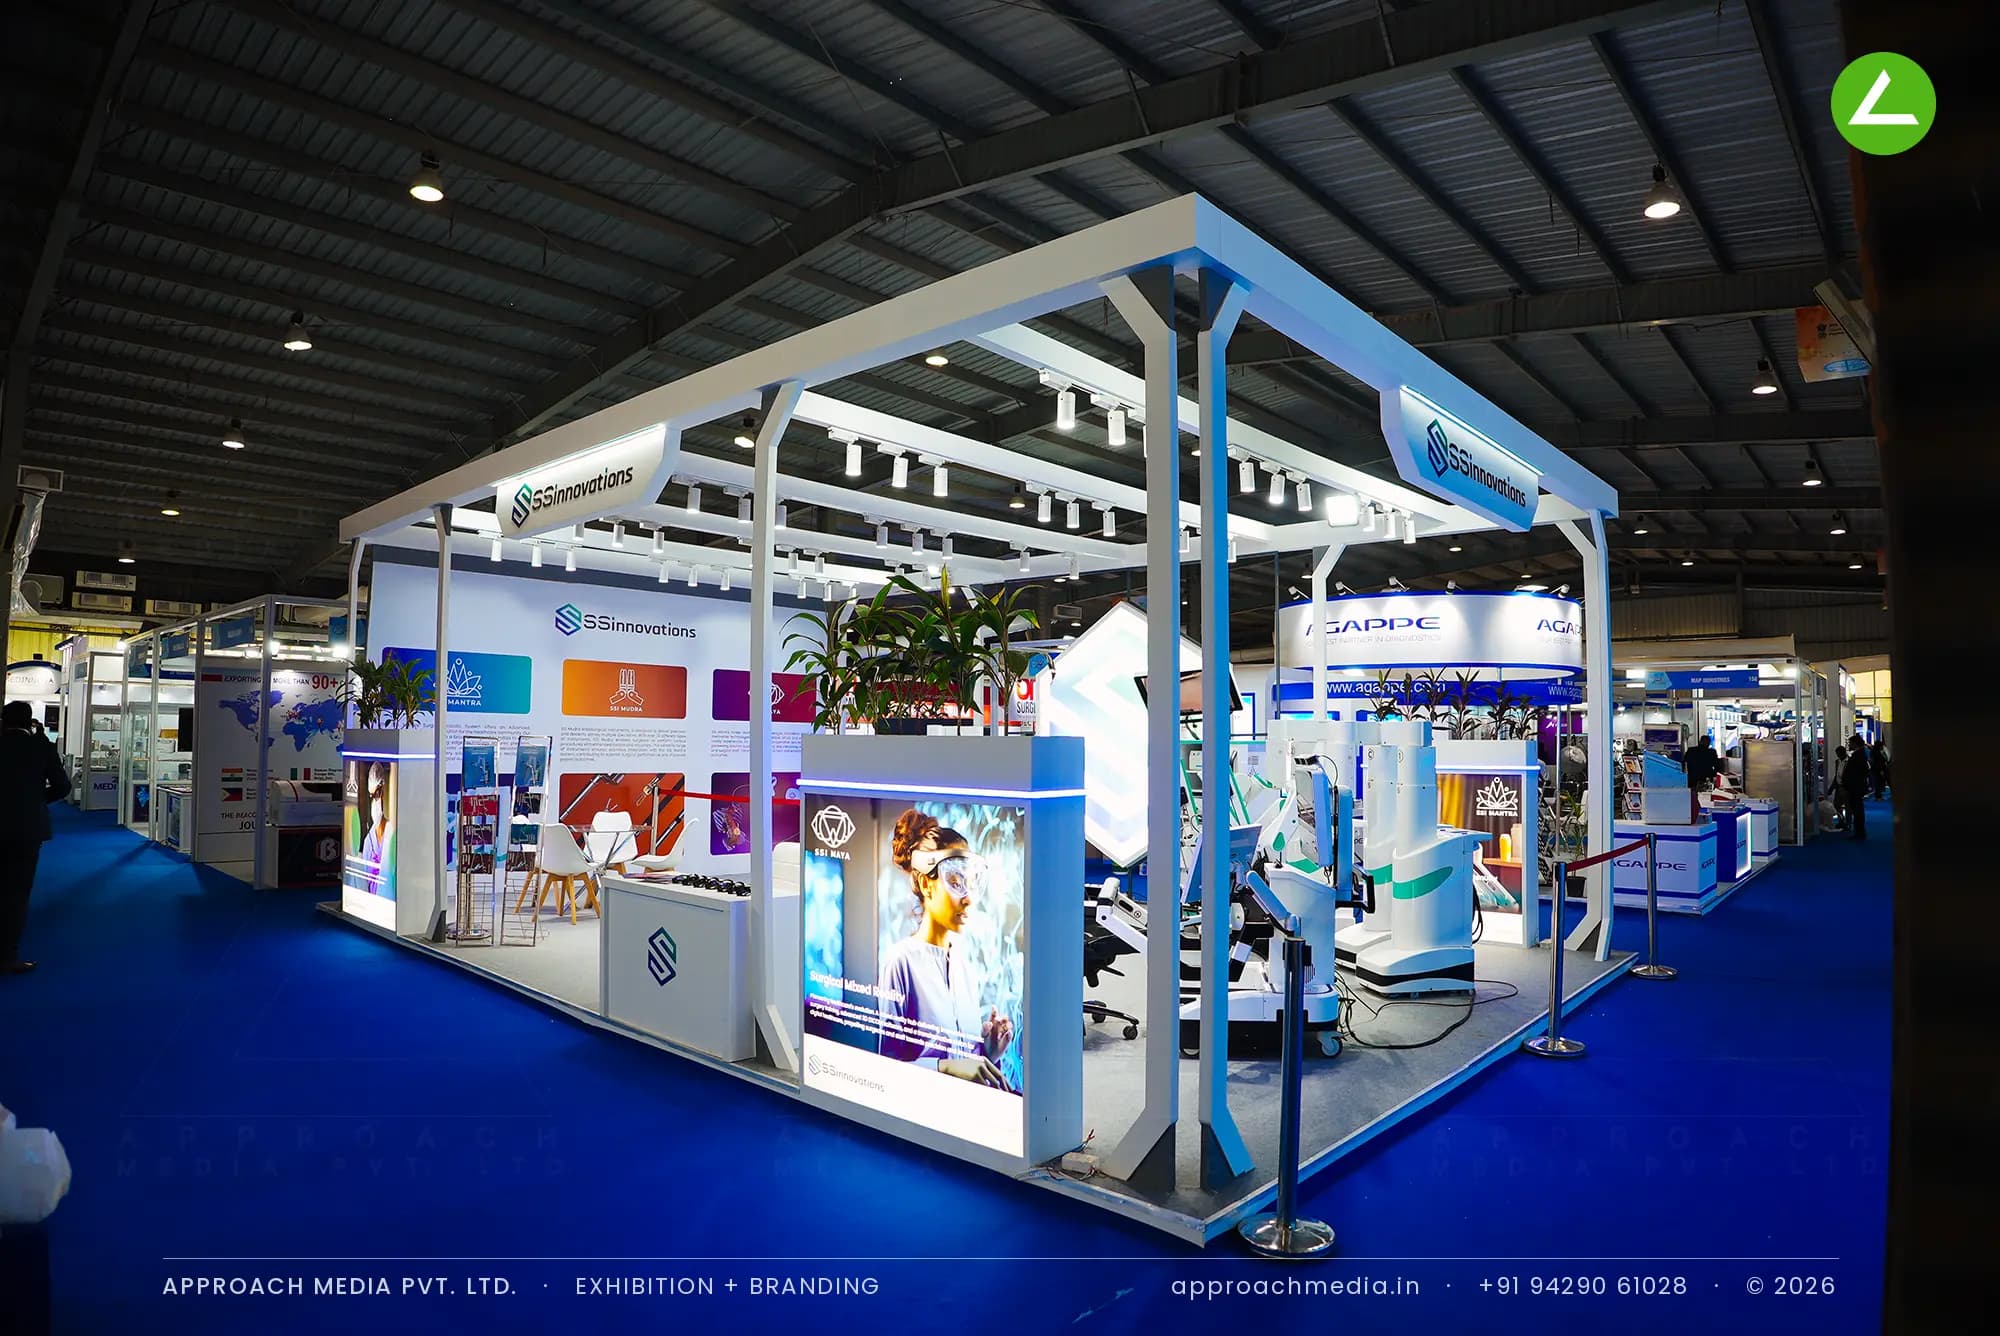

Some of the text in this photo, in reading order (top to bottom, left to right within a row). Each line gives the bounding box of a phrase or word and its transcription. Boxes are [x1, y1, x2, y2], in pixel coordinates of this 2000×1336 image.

[1448, 442, 1527, 508] SSinnovations
[531, 466, 633, 511] SSinnovations
[583, 613, 697, 638] SSinnovations
[311, 674, 339, 690] 90+
[447, 699, 482, 707] MANTRA
[620, 705, 643, 713] MUDRA
[814, 847, 829, 857] SSI
